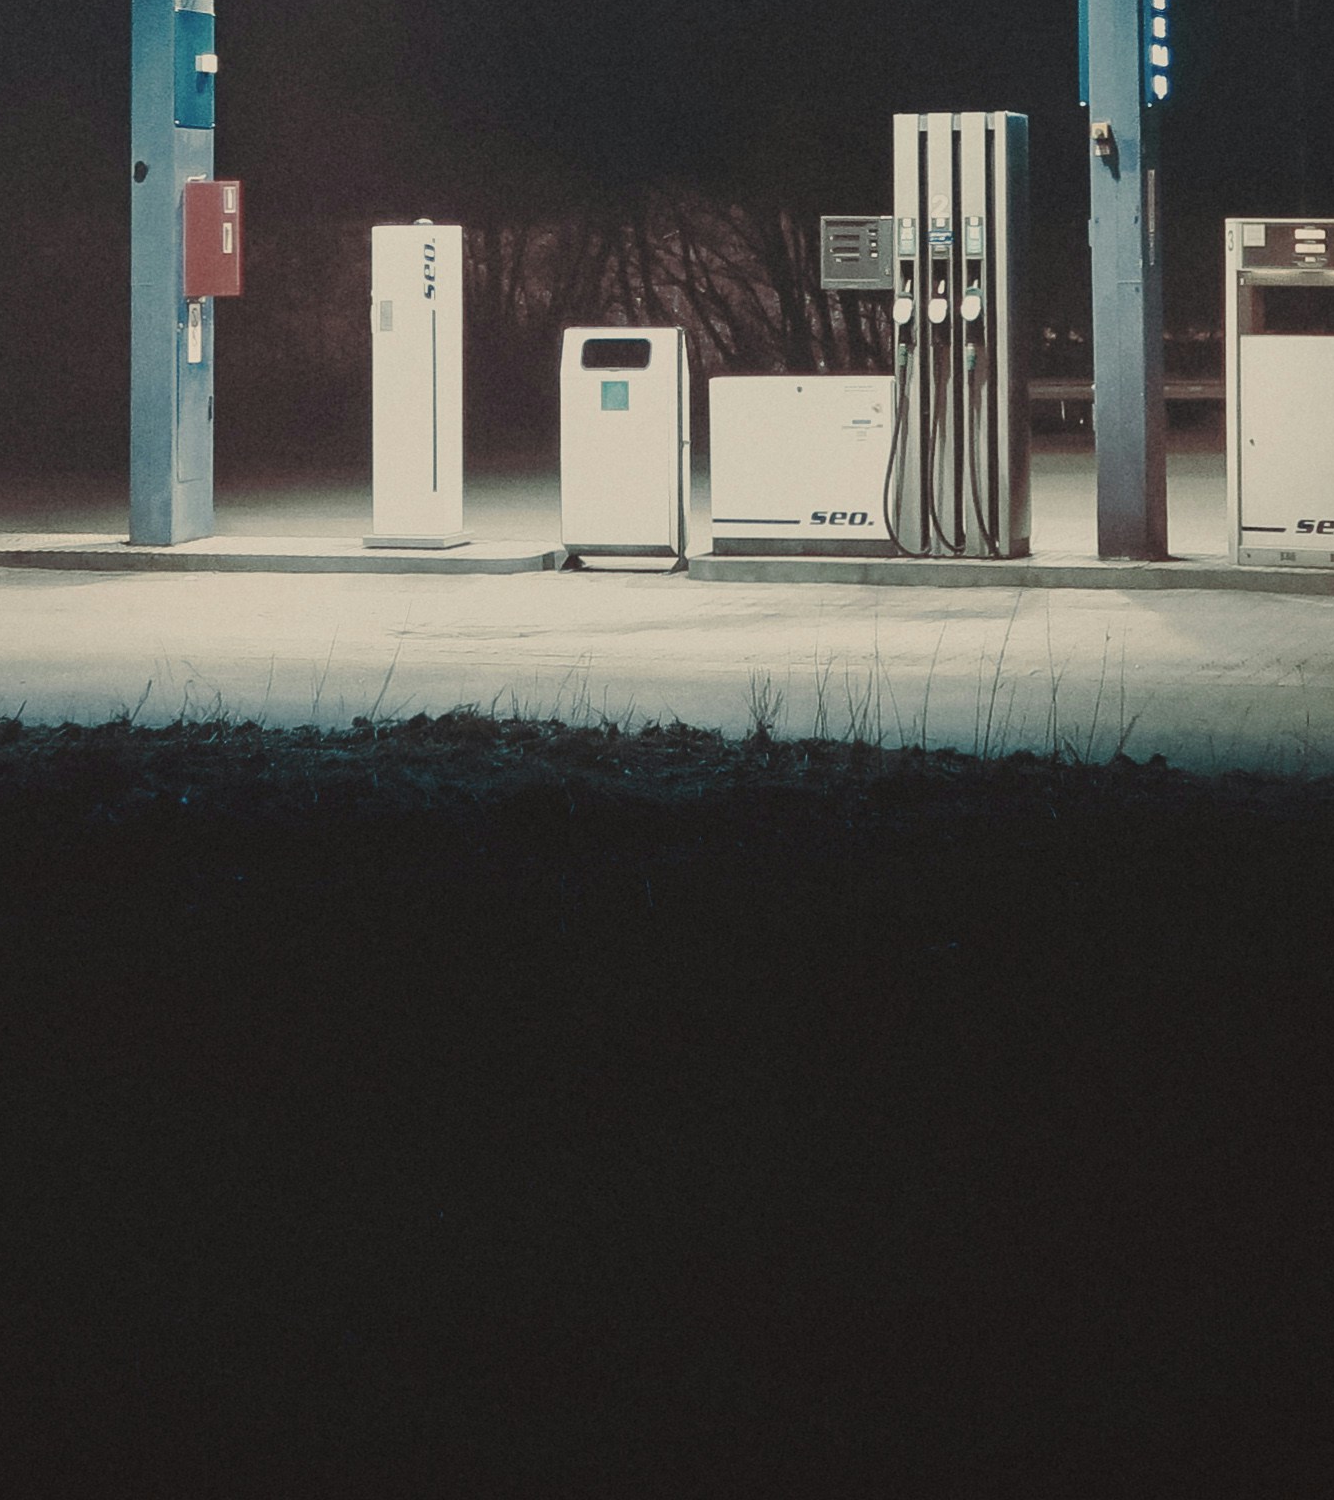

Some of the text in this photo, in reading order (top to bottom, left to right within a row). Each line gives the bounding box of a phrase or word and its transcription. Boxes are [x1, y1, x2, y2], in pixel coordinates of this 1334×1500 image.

[931, 194, 949, 218] 2
[1228, 230, 1235, 251] 3
[424, 238, 435, 300] seo.
[809, 510, 875, 526] seo.
